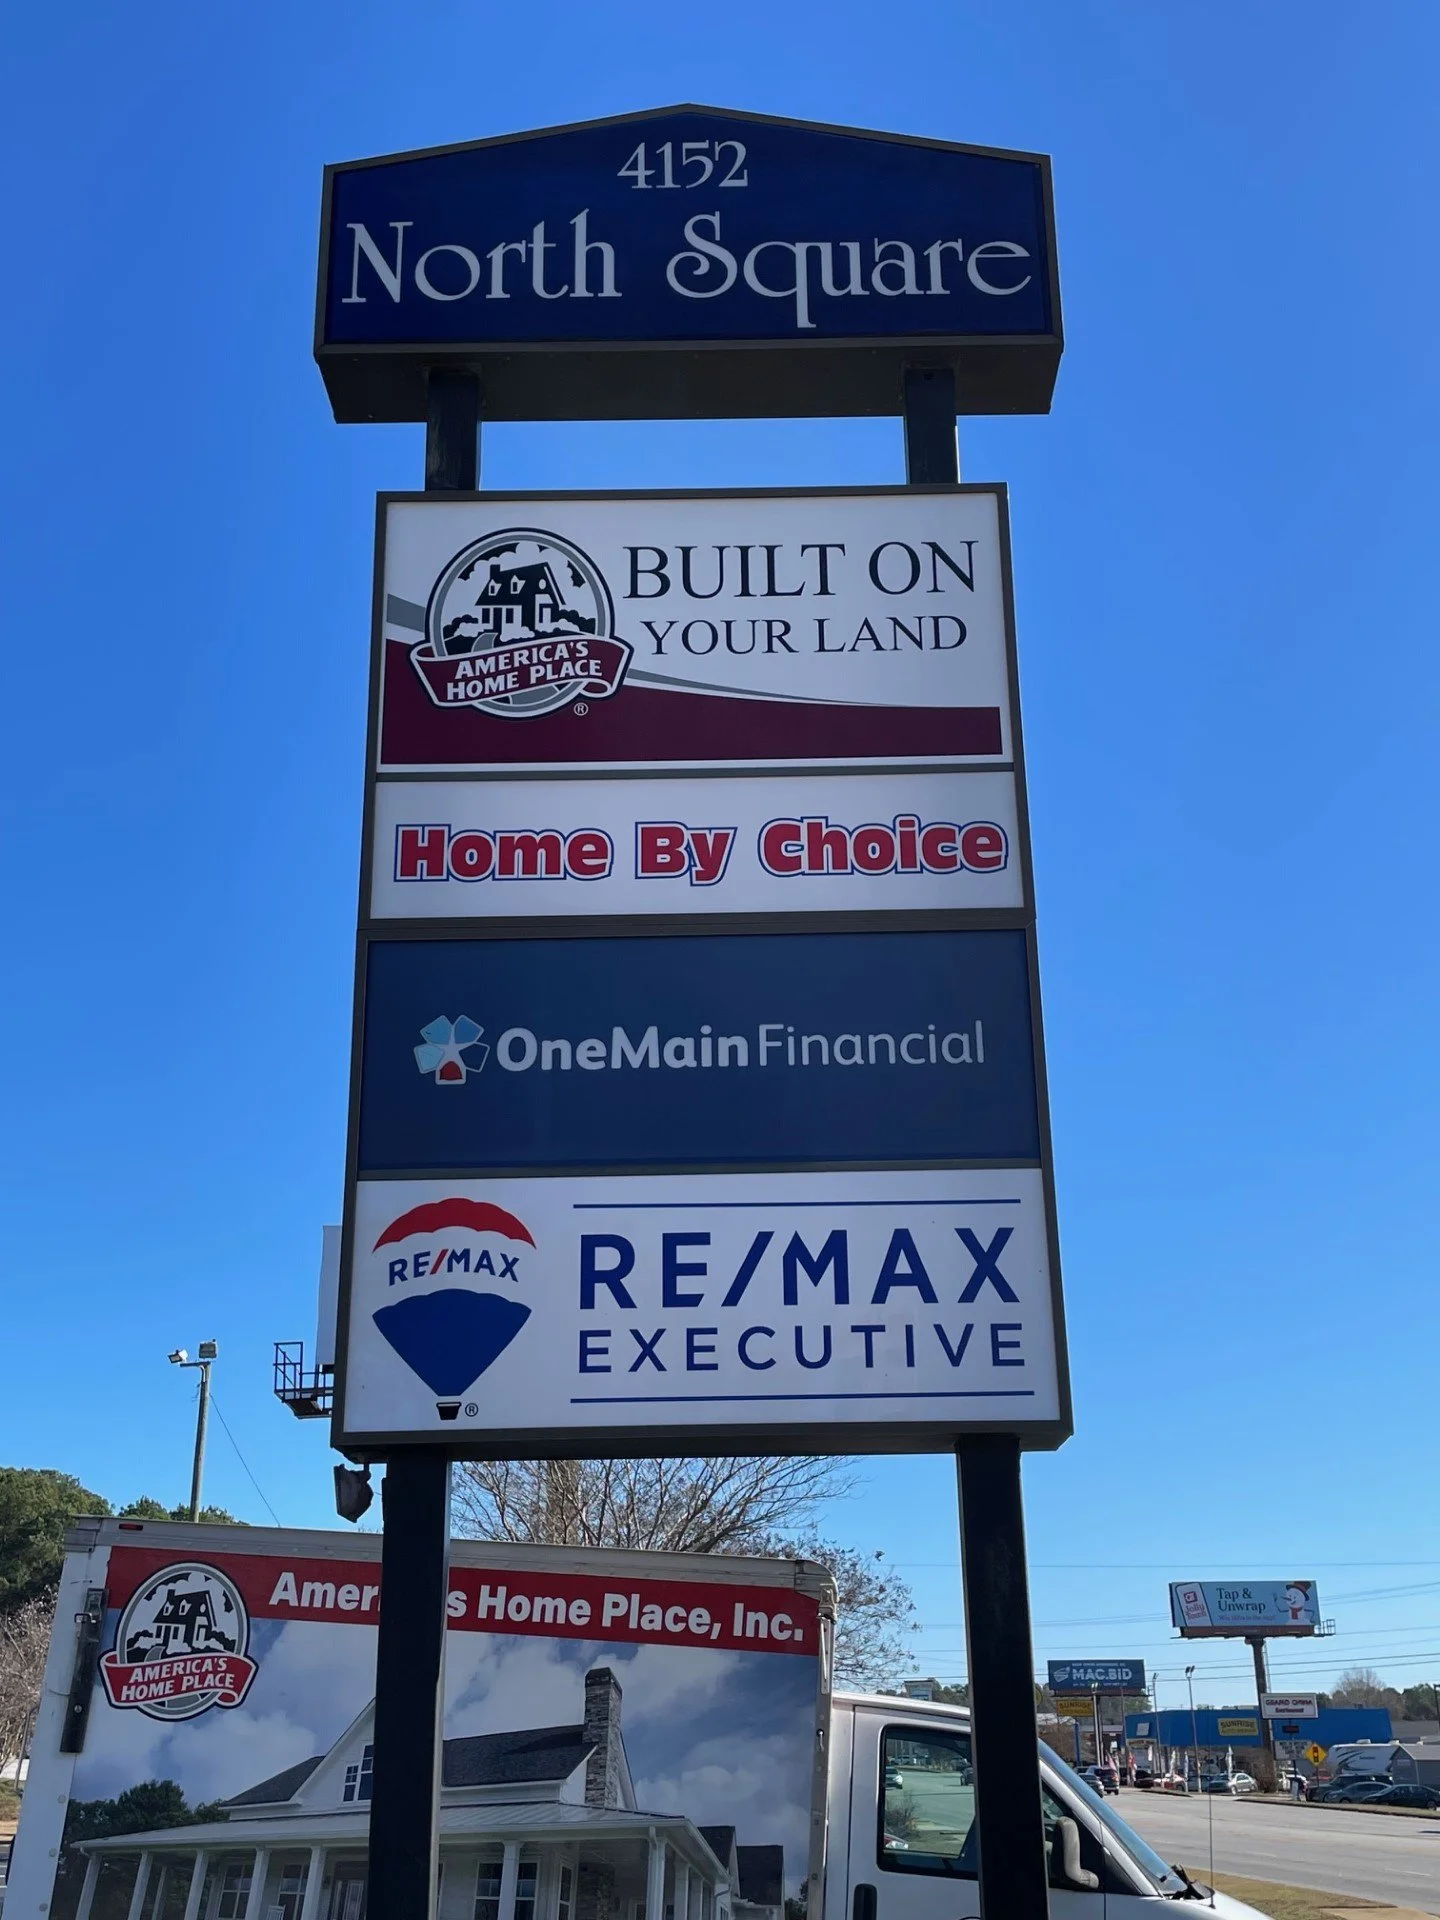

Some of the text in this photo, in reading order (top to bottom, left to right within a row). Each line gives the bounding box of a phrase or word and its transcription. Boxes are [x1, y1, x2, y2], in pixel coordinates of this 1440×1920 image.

[616, 140, 749, 190] 4152
[341, 208, 1032, 329] North Square
[622, 540, 979, 600] BUILT ON
[640, 615, 967, 655] YOUR LAND
[446, 659, 603, 701] HOME PLACE
[454, 641, 589, 680] AMERICA'S
[394, 815, 1008, 886] Home By Choice
[388, 1245, 520, 1287] RE/MAX
[578, 1226, 1020, 1310] RE/MAX
[578, 1323, 1025, 1374] EXECUTIVE
[477, 1584, 592, 1626] Home
[602, 1592, 722, 1640] Place,
[732, 1602, 804, 1642] Inc.
[1216, 1588, 1253, 1602] Tap &
[1217, 1600, 1267, 1614] Unwrap
[120, 1672, 235, 1701] HOME PLACE
[129, 1657, 228, 1684] AMERICA'S
[1072, 1668, 1132, 1680] MAC.BID
[1221, 1719, 1254, 1728] SUNRISE
